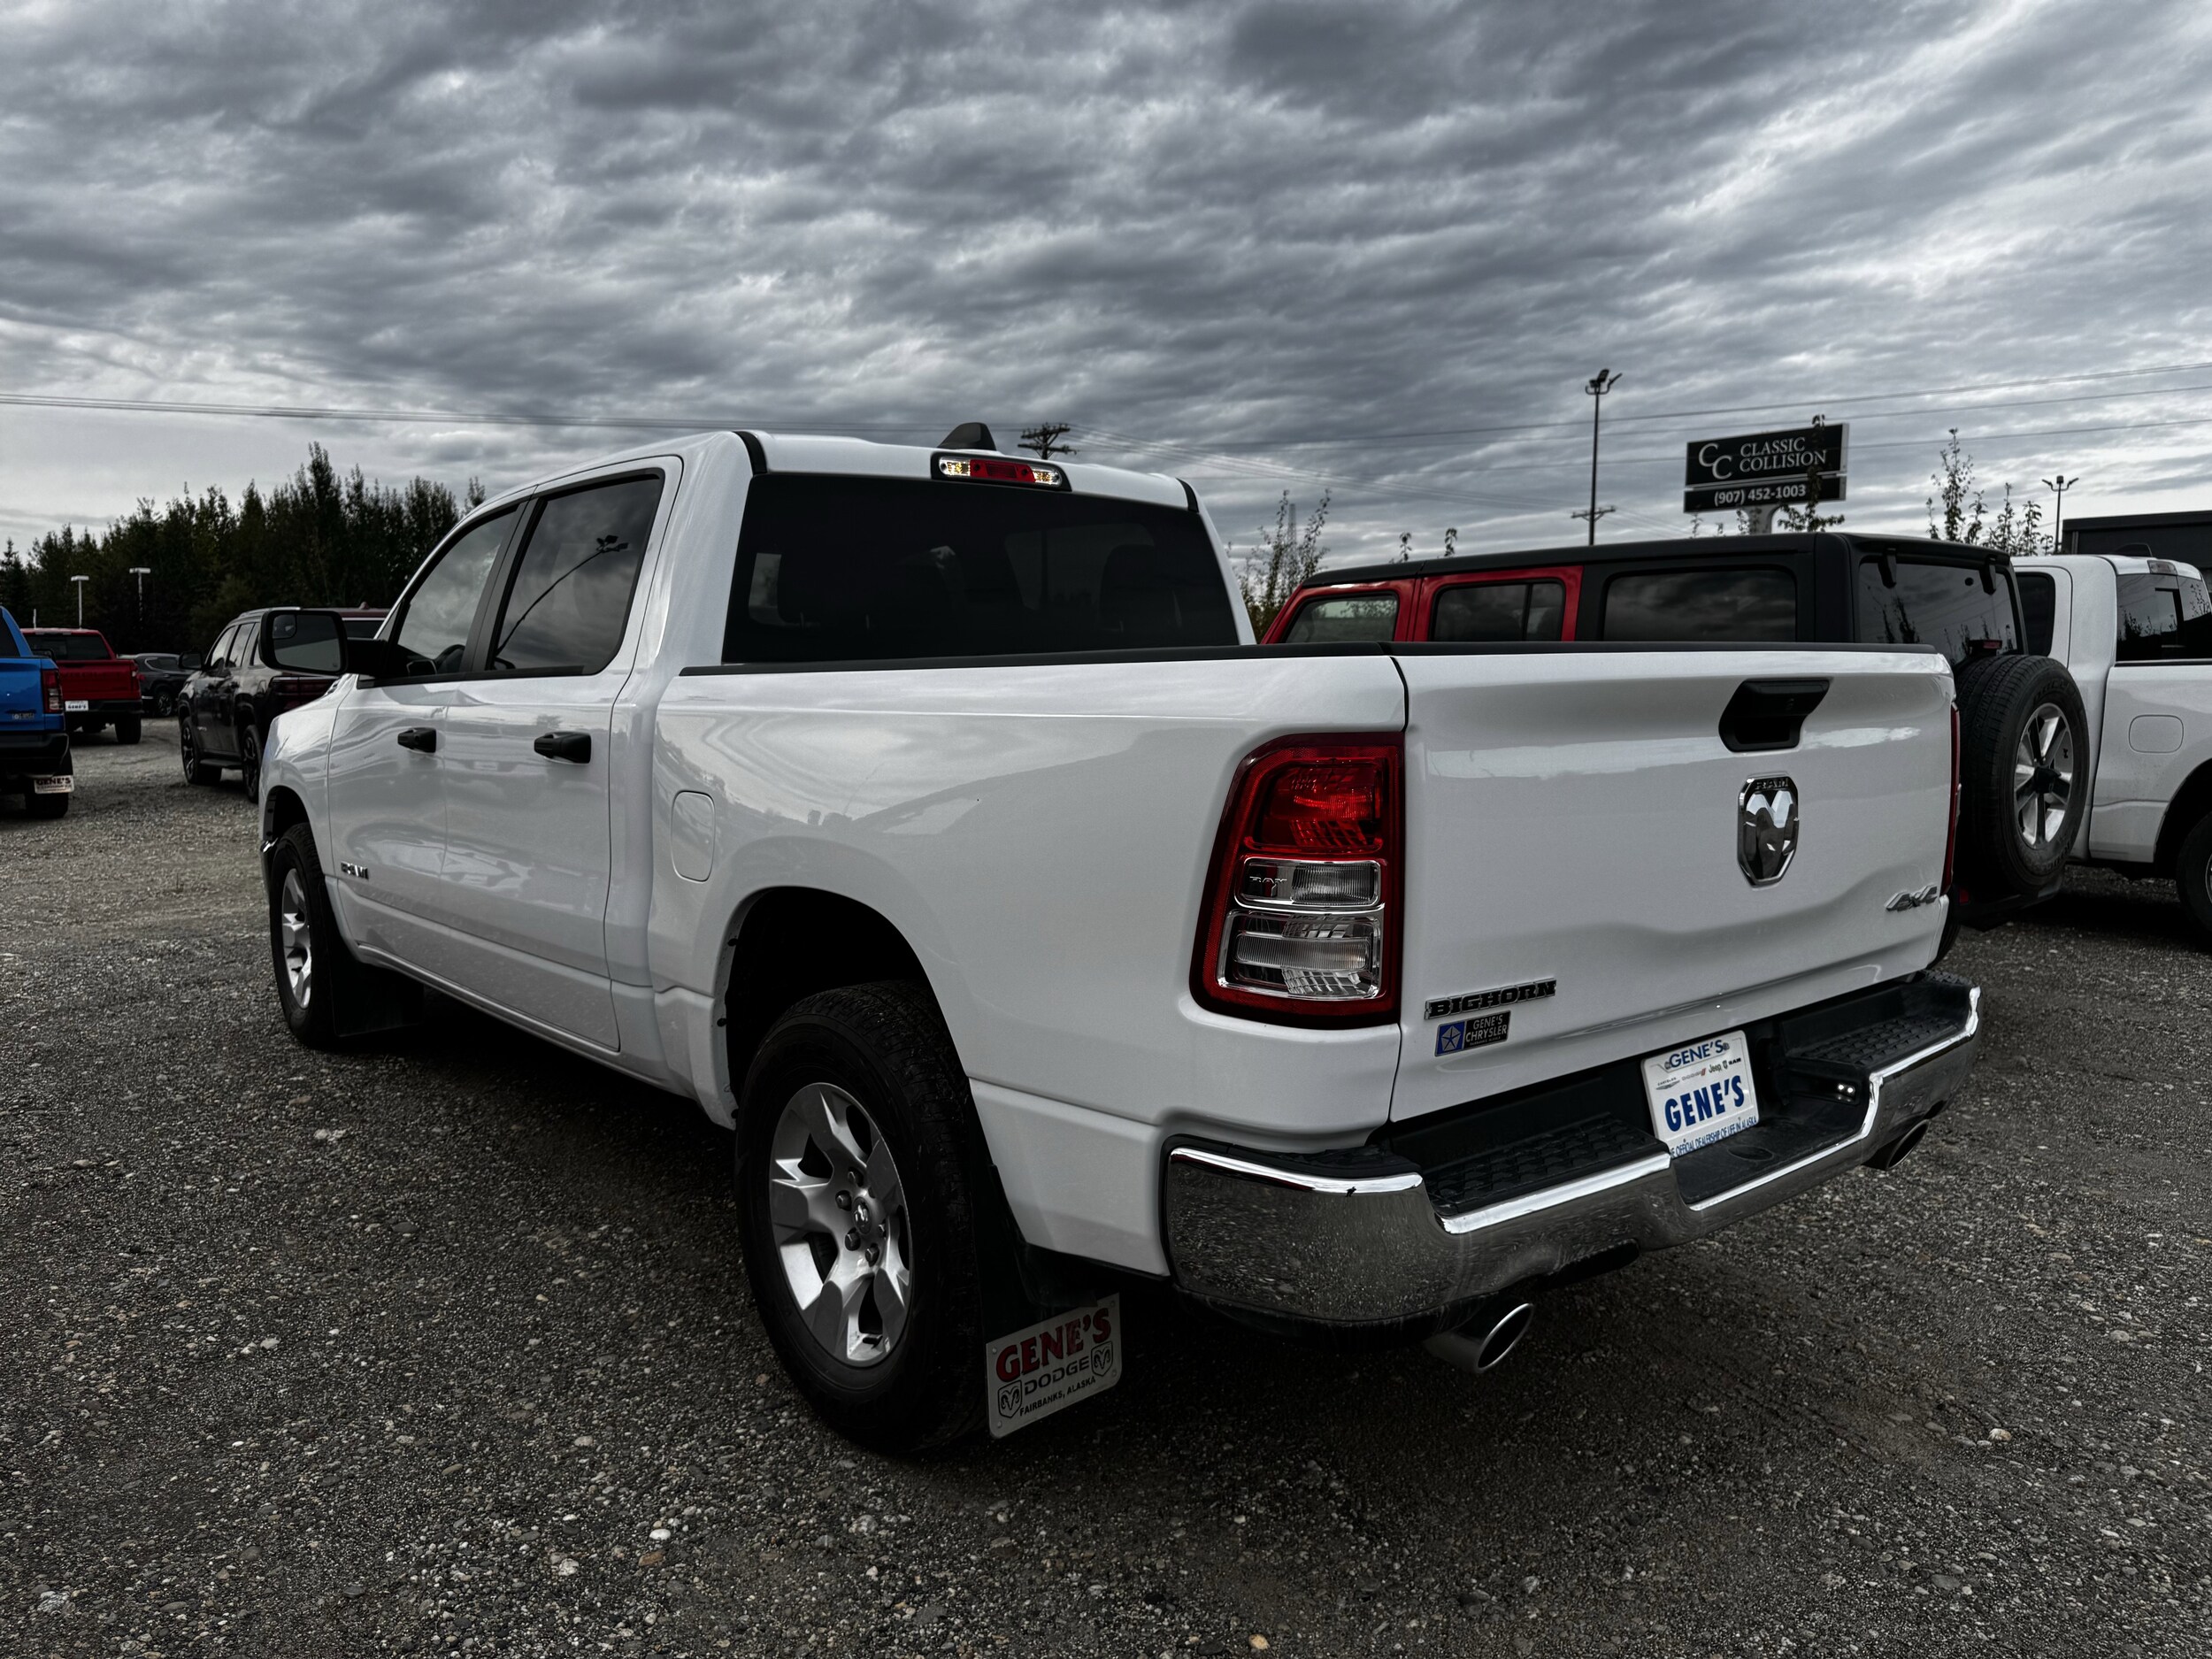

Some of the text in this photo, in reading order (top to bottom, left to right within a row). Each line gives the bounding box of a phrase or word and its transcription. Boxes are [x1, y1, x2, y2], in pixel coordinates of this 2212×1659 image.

[1740, 437, 1806, 457] CLASSIC
[1740, 449, 1827, 472] COLLISION
[1714, 484, 1806, 507] (907) 452-1003
[1755, 777, 1789, 791] RAM
[1425, 978, 1556, 1019] BIGHORN
[1465, 1024, 1508, 1043] CHRYSLER
[1473, 1015, 1503, 1031] GENE'S
[1670, 1040, 1724, 1068] GENE'S
[1709, 1063, 1724, 1073] Jeep
[1664, 1075, 1745, 1132] GENE'S
[1676, 1141, 1696, 1156] OFFICIAL
[1695, 1130, 1720, 1149] DEALERSHIP
[1720, 1128, 1727, 1139] OF
[1726, 1124, 1736, 1136] LIFE
[1736, 1121, 1742, 1132] IN
[1741, 1116, 1756, 1129] ALASKA
[996, 1308, 1111, 1382] GENE'S
[1025, 1356, 1090, 1396] DODGE
[1020, 1376, 1096, 1416] FAIRBANKS, ALASKA
